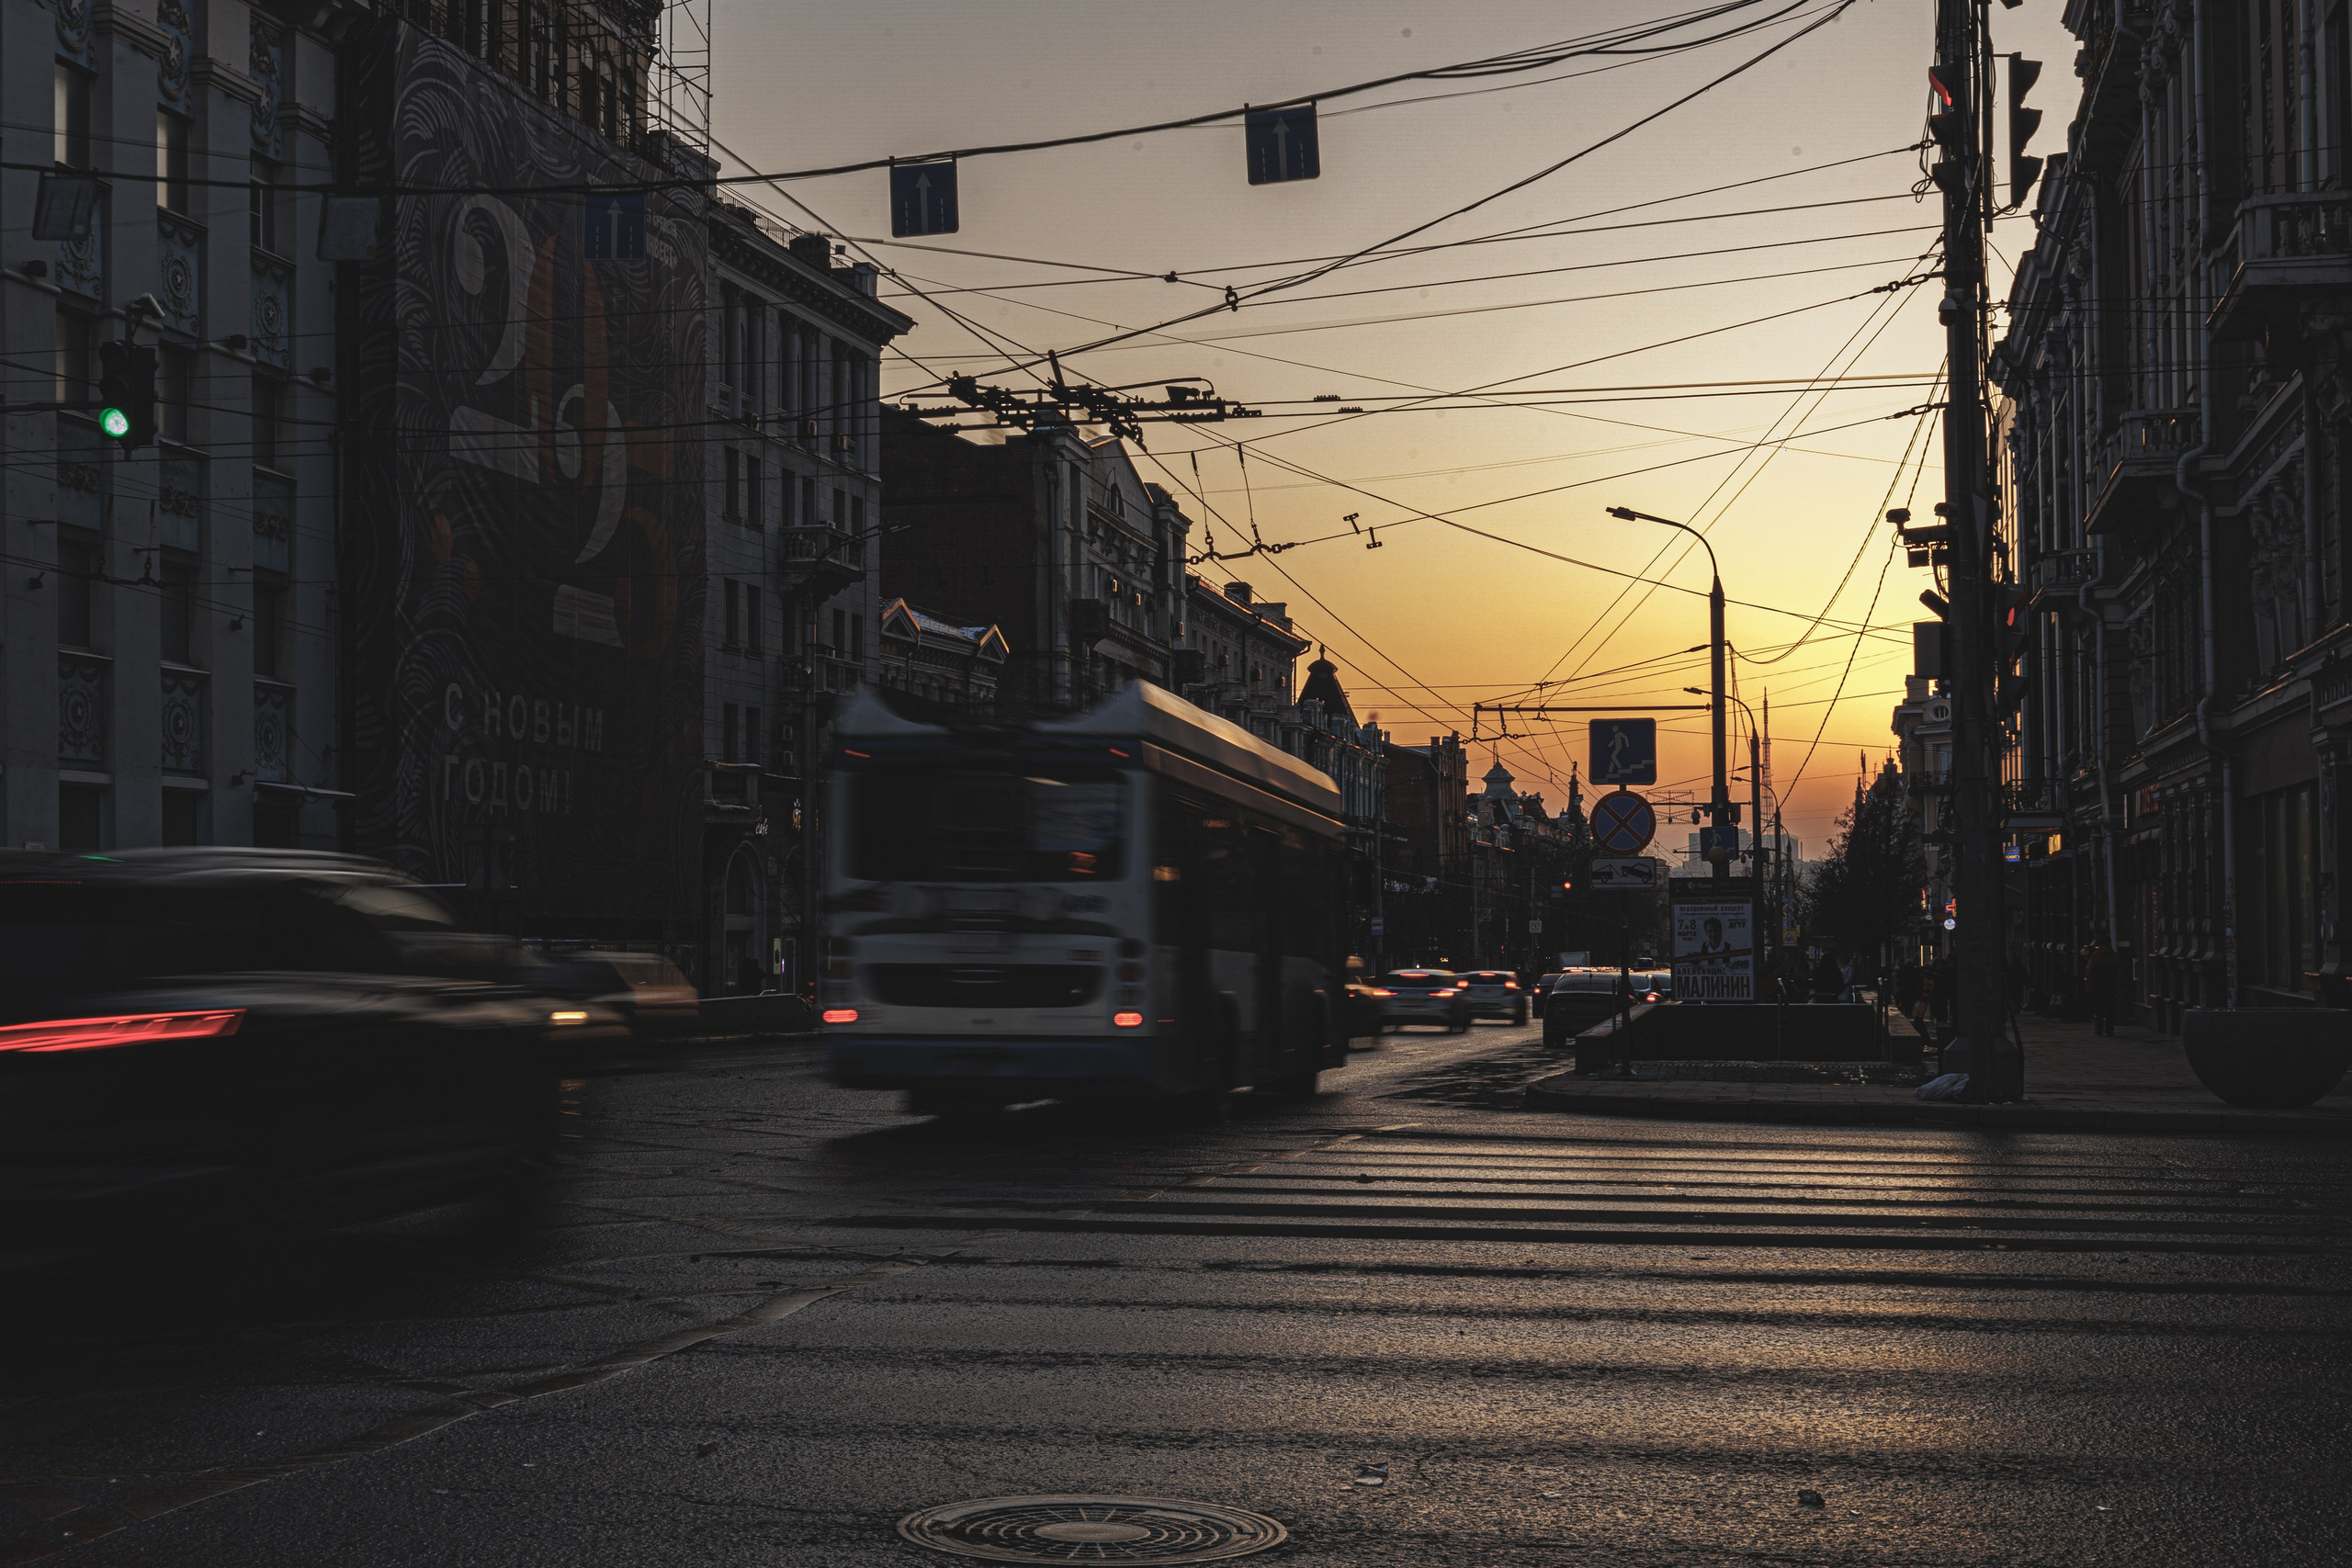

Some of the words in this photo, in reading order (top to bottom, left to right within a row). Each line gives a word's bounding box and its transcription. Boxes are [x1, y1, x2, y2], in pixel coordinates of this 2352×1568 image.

[445, 682, 463, 730] С
[483, 689, 604, 752] НОВЫМ
[444, 754, 573, 818] ГОДОМ!
[1678, 919, 1684, 931] 7
[1690, 919, 1697, 931] 8
[1728, 921, 1747, 930] ДГТУ
[1677, 976, 1750, 998] МАЛИНИН
